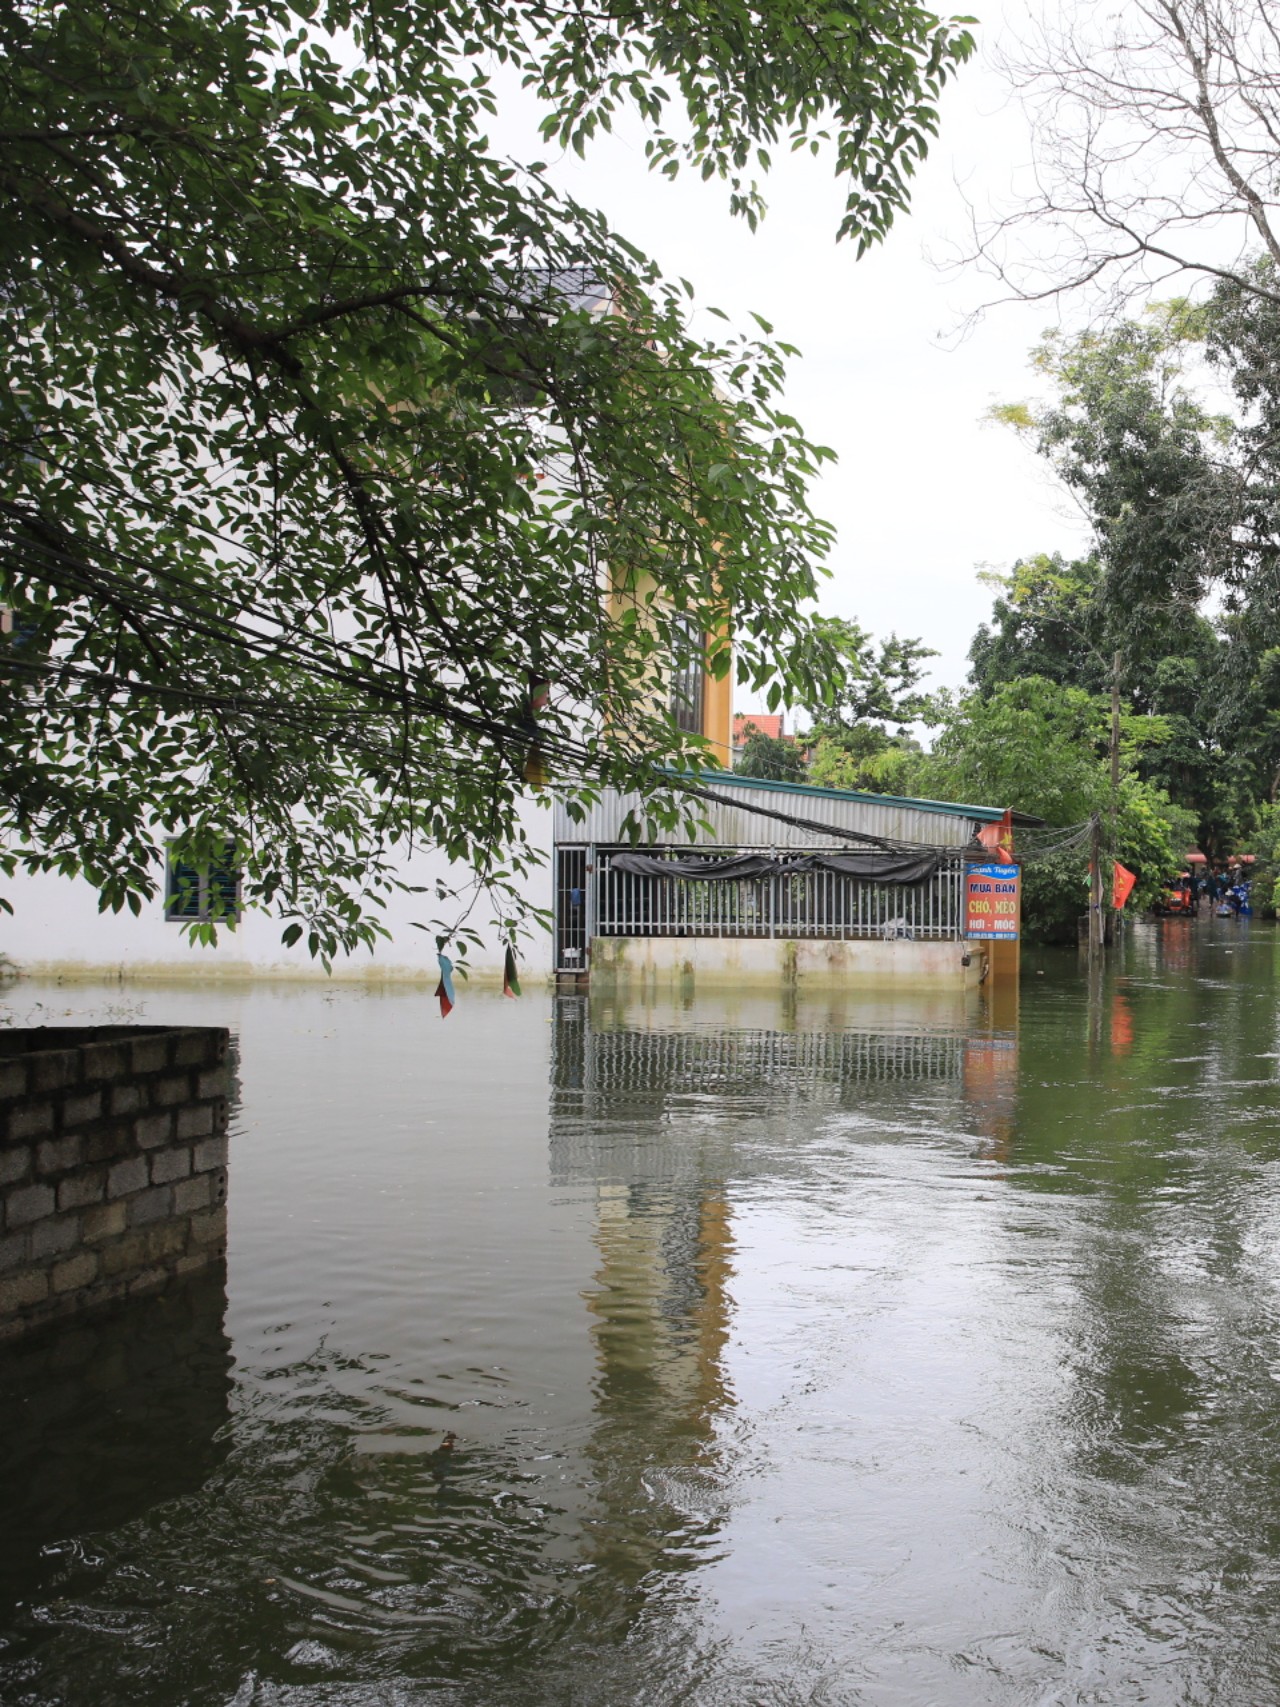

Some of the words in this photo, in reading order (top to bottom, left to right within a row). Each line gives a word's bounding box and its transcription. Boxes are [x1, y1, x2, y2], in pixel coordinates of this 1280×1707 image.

[970, 883, 992, 893] MUA
[968, 897, 992, 915] CHÓ,
[994, 897, 1016, 914] MÈO
[994, 917, 1016, 930] MÓC
